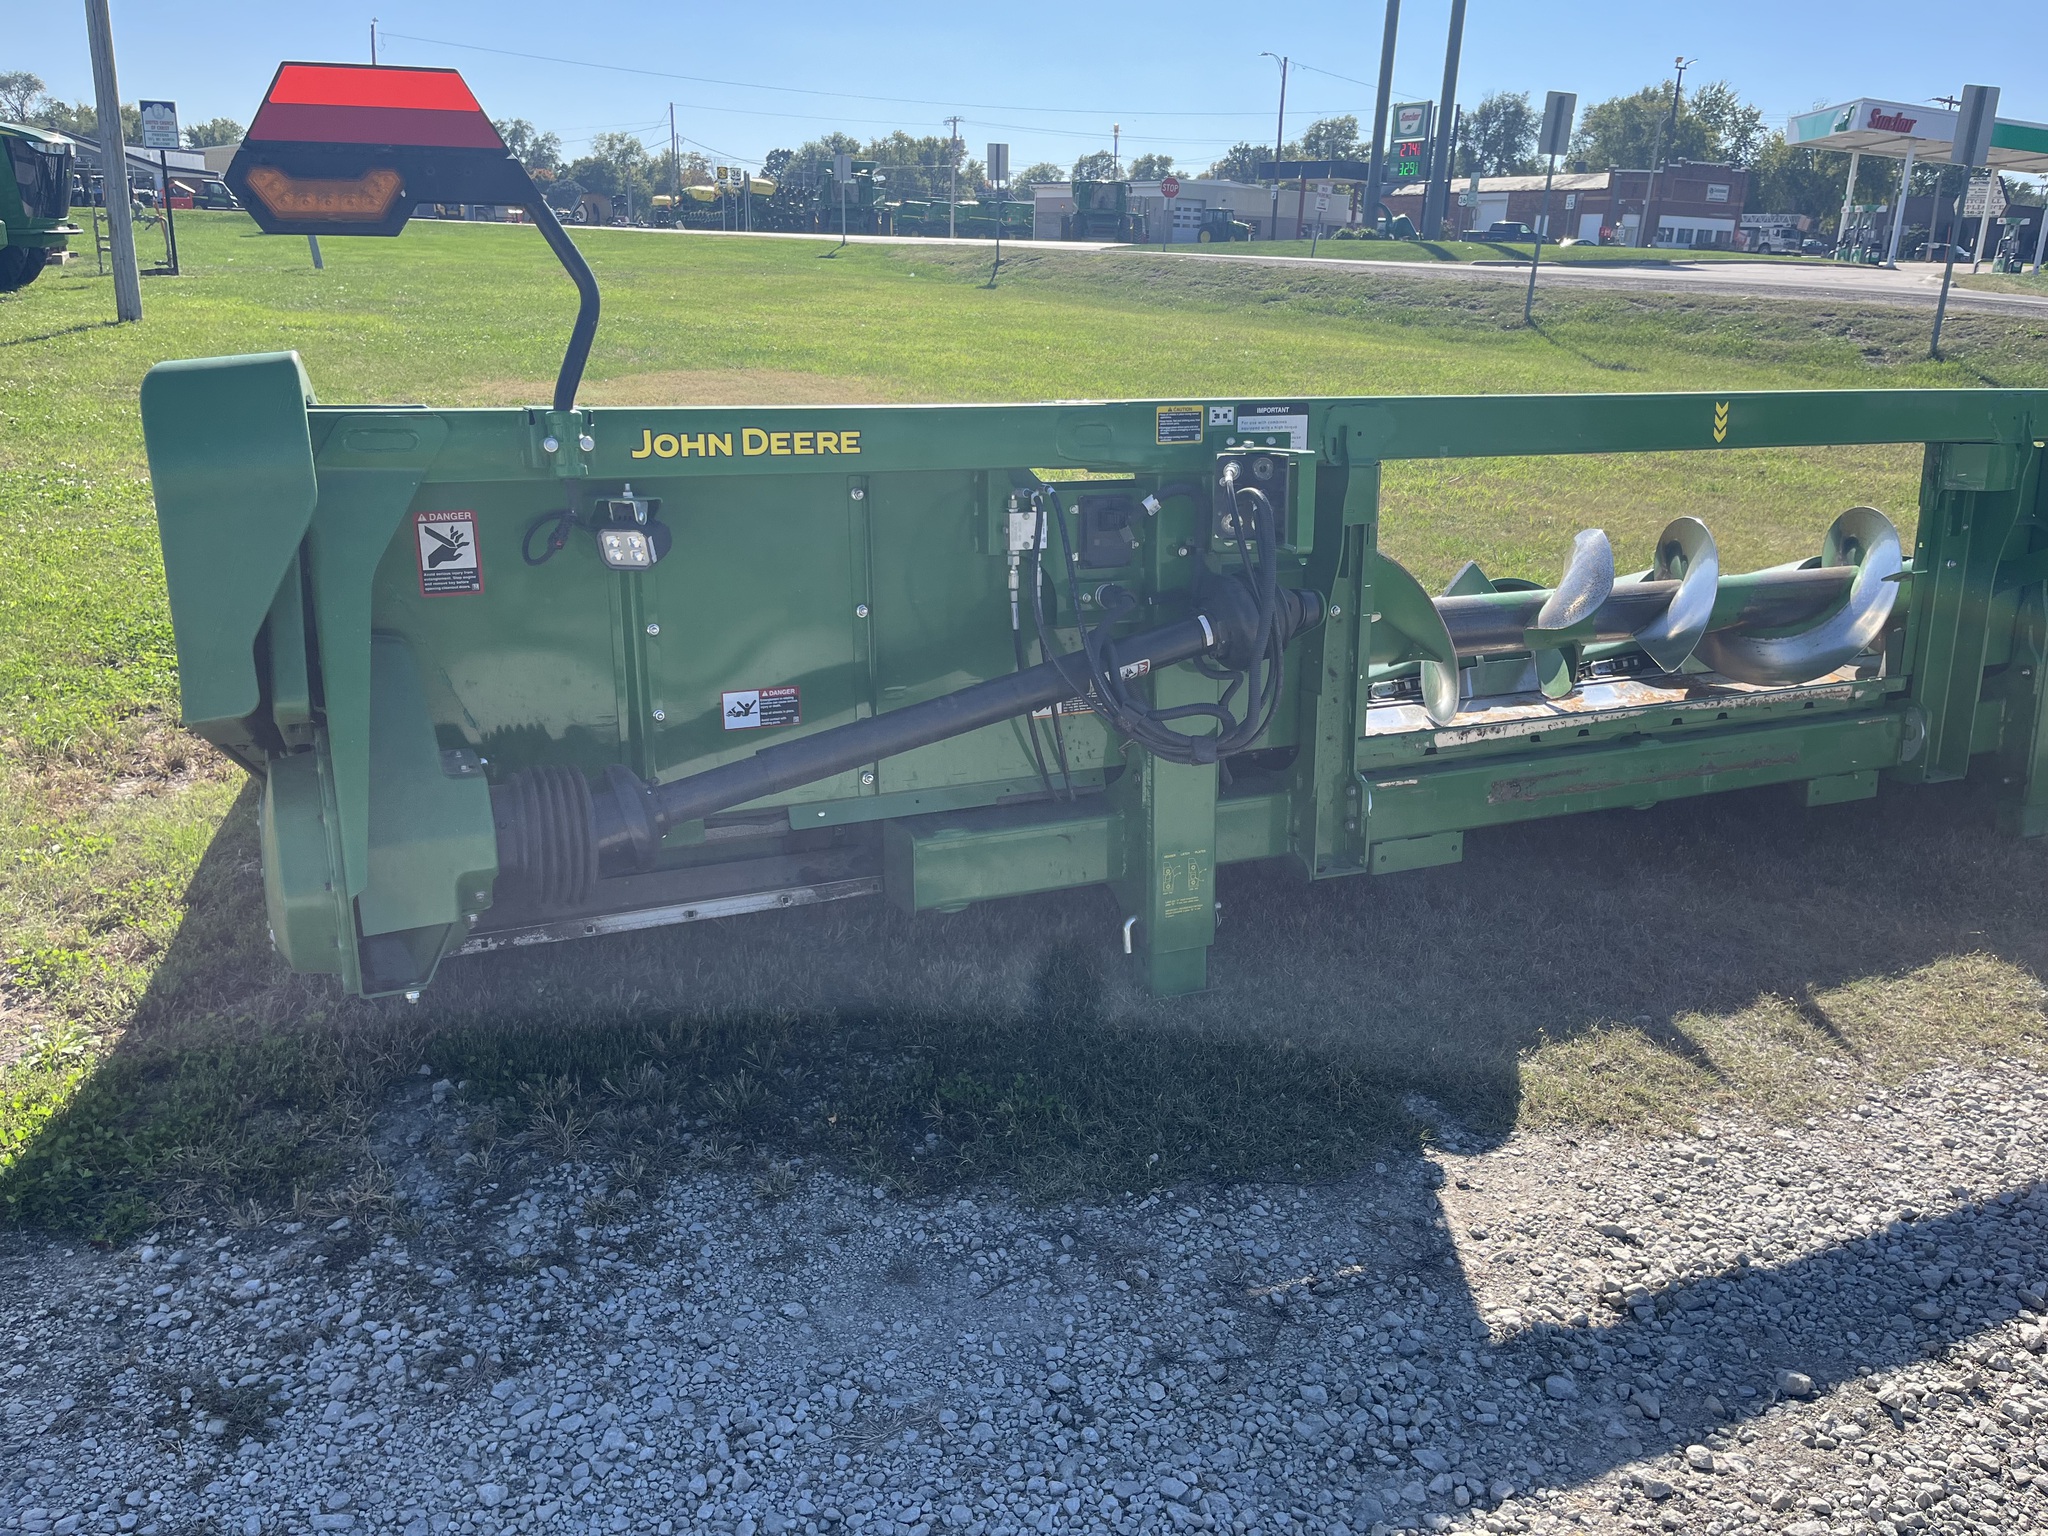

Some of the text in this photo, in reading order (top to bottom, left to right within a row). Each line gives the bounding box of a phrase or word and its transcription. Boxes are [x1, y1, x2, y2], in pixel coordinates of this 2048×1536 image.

[1400, 112, 1421, 121] Sinclair
[1867, 108, 1917, 133] Sinclair
[1162, 184, 1179, 192] STOP
[631, 427, 861, 459] JOHN DEERE
[428, 512, 472, 521] DANGER
